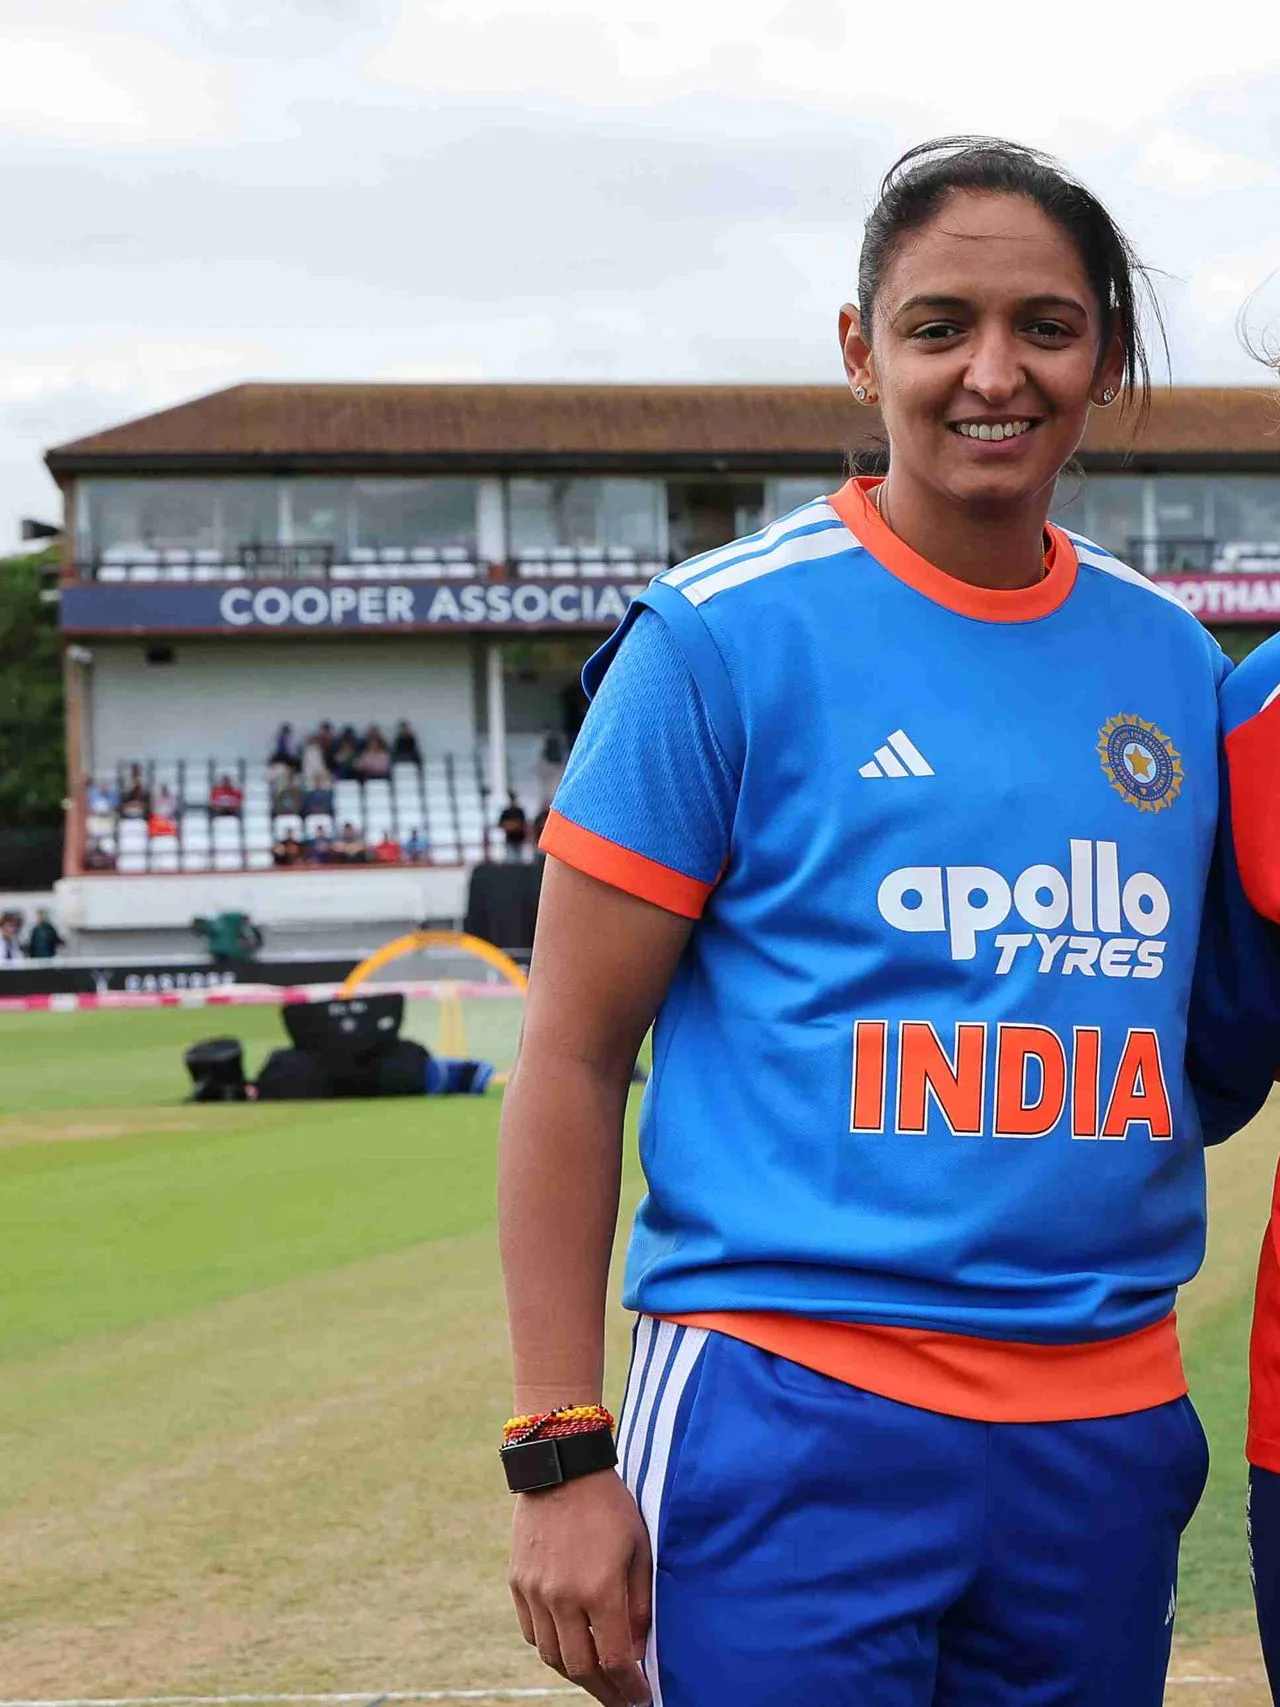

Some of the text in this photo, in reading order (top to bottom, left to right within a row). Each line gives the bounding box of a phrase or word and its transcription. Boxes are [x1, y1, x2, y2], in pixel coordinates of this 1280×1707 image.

[219, 585, 416, 627] COOPER
[877, 838, 1171, 961] apollo
[994, 933, 1167, 979] TYRES
[849, 1019, 1173, 1141] INDIA
